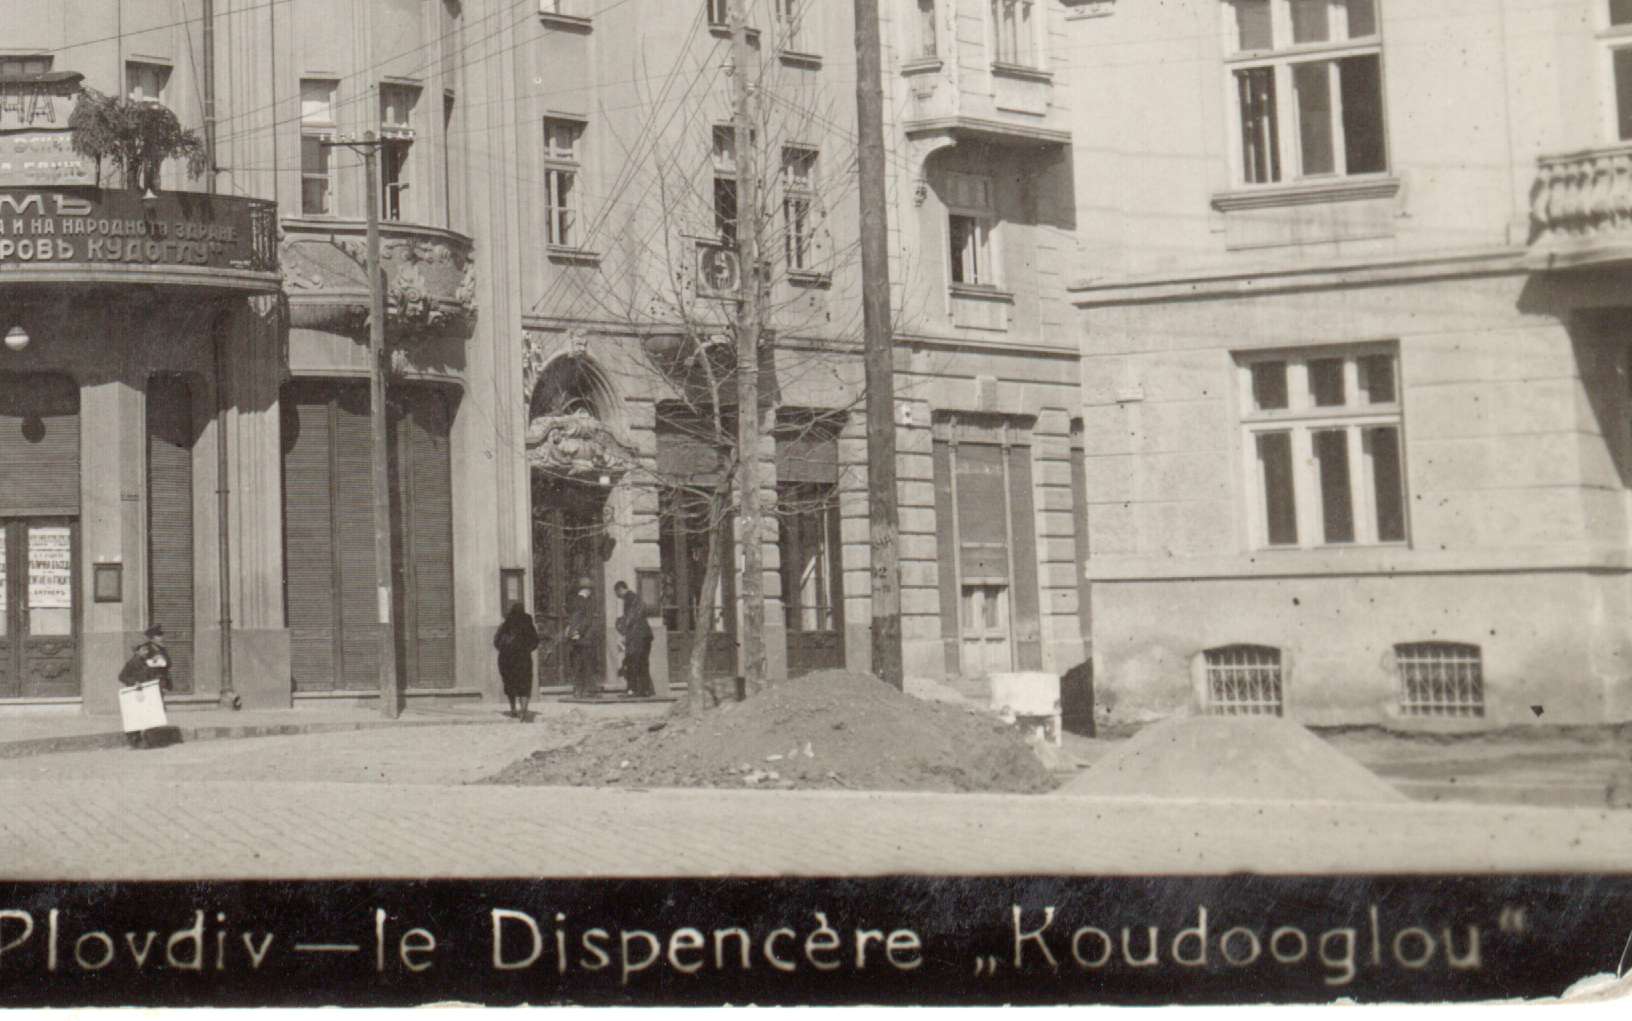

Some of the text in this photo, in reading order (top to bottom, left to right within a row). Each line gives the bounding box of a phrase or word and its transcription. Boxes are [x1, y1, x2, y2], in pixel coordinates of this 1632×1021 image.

[12, 218, 25, 236] И
[31, 218, 56, 236] НА
[62, 218, 168, 238] НАРОДНОТО
[174, 222, 238, 244] ЗДРАВЕ
